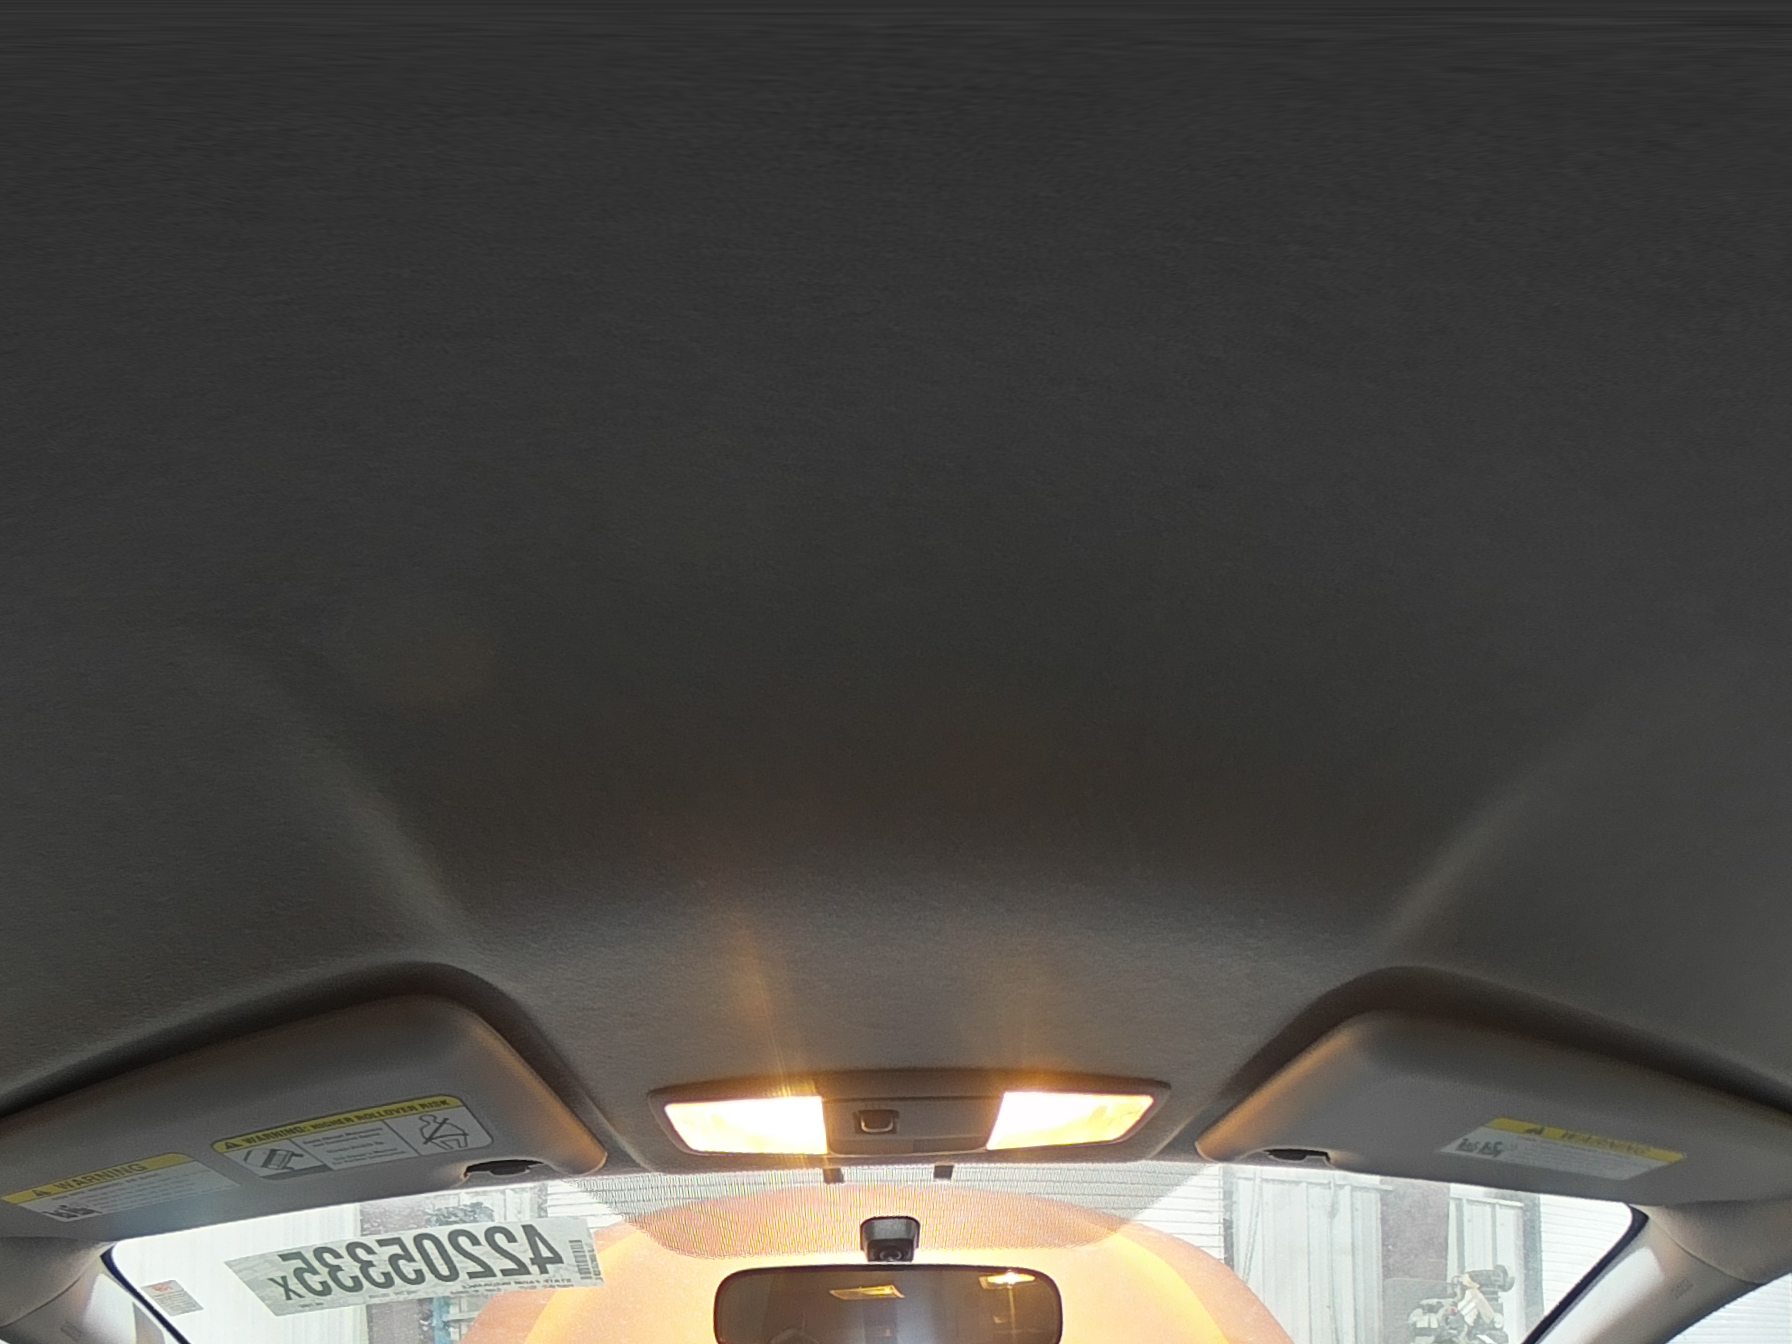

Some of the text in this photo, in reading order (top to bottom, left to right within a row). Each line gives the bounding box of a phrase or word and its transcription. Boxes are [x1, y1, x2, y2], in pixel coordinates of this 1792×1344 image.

[241, 1098, 452, 1146] WARNING: HIGHER ROLLOVER RISK
[53, 1162, 148, 1191] WARNING
